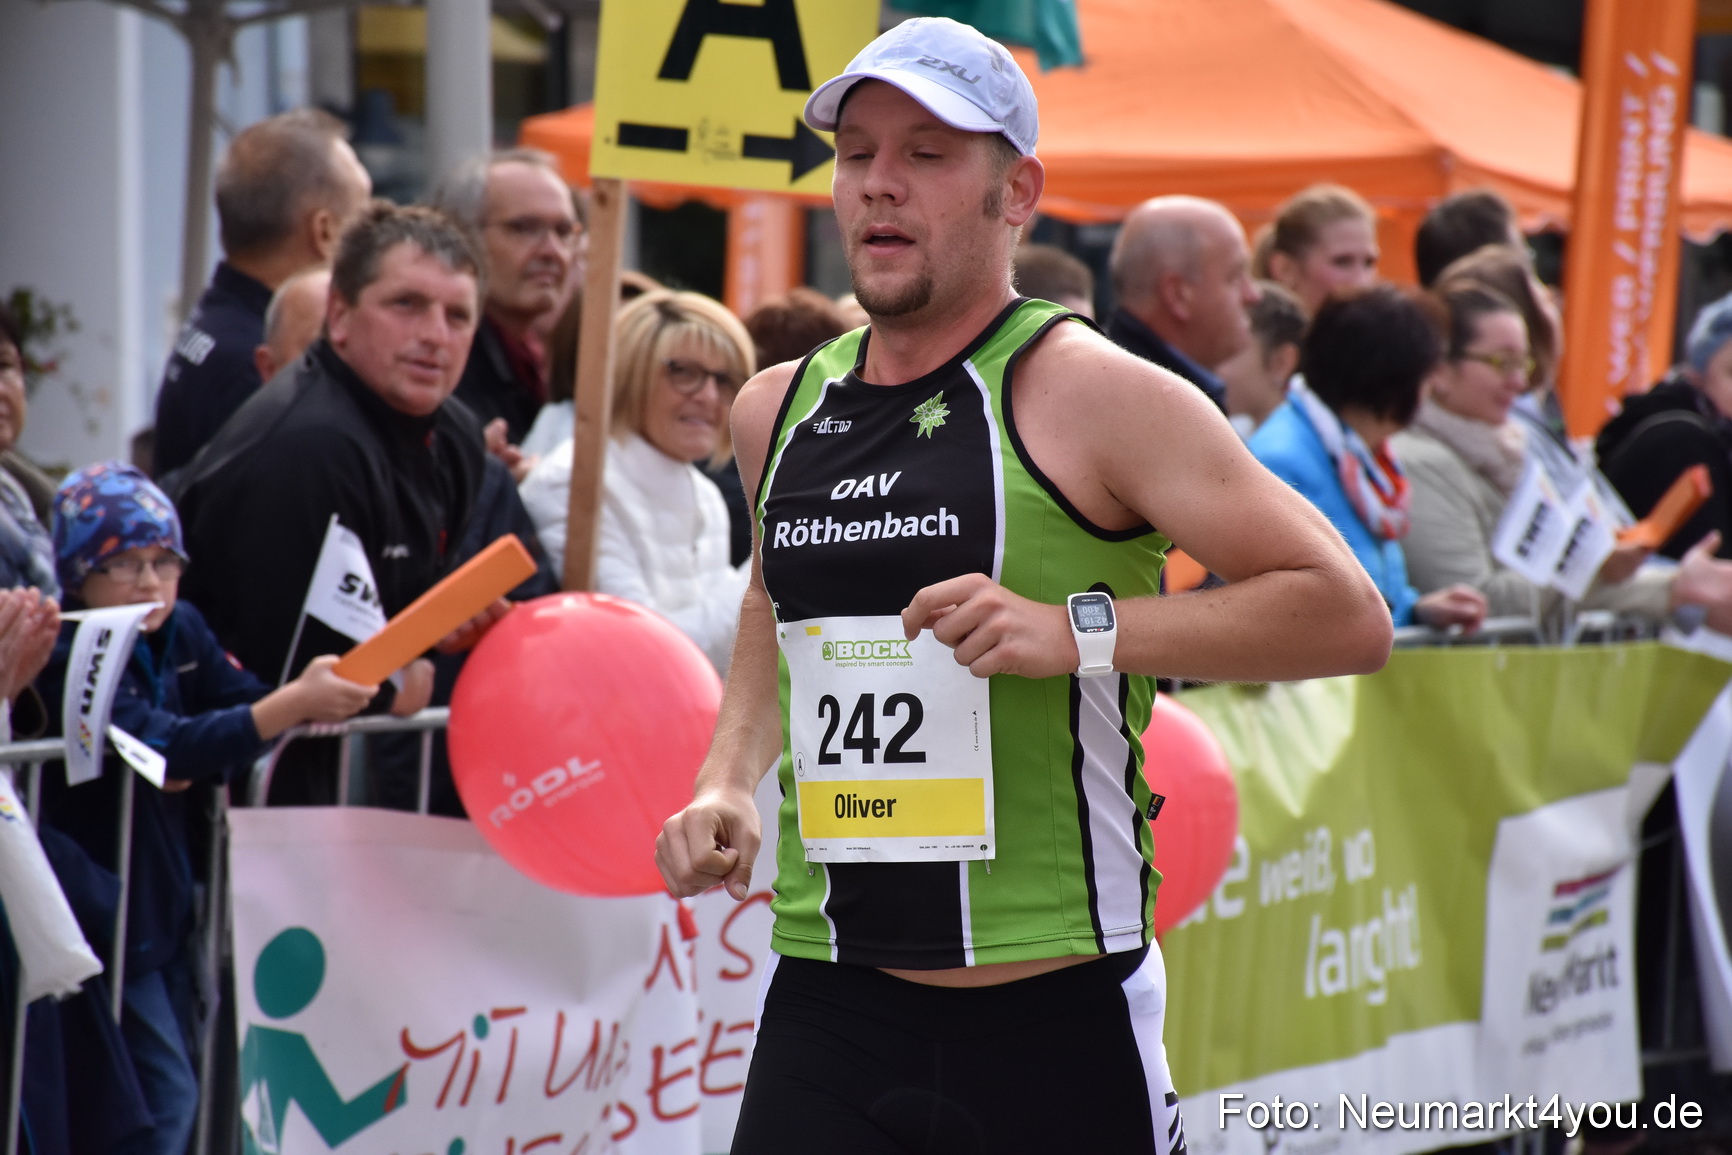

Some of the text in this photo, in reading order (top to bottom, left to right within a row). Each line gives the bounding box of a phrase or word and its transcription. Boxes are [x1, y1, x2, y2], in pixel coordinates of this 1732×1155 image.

[656, 0, 813, 92] A
[916, 54, 982, 84] 2XU
[830, 471, 902, 500] DAV
[773, 507, 960, 549] Röthenbach
[835, 640, 913, 660] BOCK
[885, 660, 914, 668] concepts
[818, 692, 927, 765] 242
[834, 793, 897, 819] Oliver
